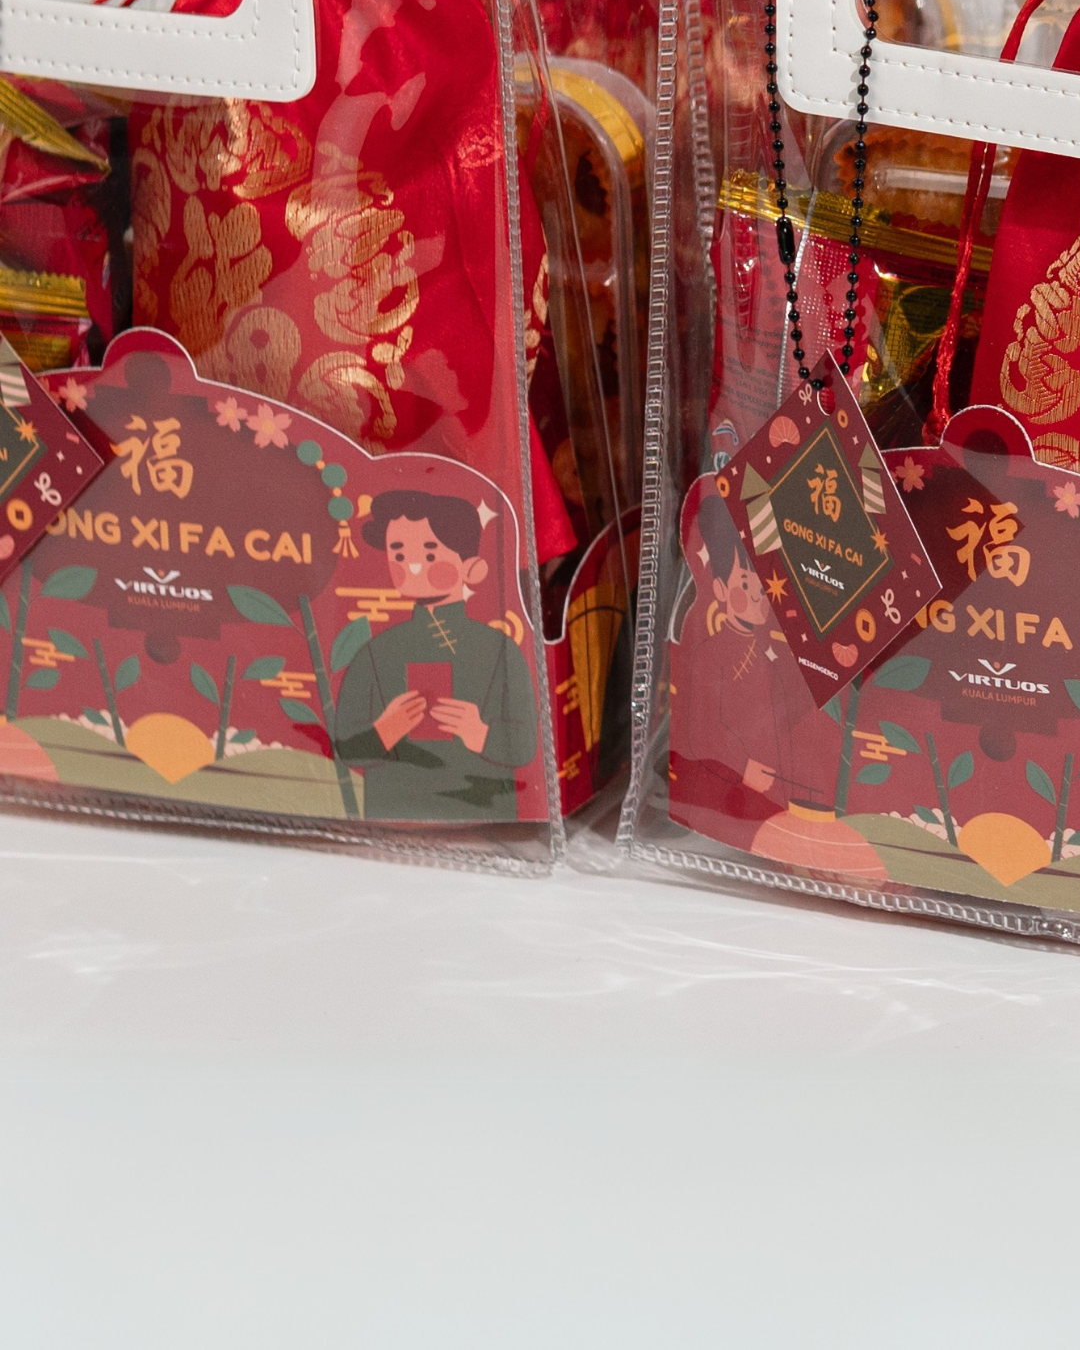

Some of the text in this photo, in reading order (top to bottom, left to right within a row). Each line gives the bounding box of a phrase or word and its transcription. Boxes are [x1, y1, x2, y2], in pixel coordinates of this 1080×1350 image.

[110, 415, 194, 499] 福
[807, 463, 842, 523] 福
[130, 515, 170, 551] XI
[179, 522, 235, 559] FA
[244, 529, 312, 564] CAI
[783, 518, 863, 567] GONG XI FA CAI
[946, 498, 1031, 587] 福
[114, 577, 213, 601] VIRTUOS
[800, 562, 845, 590] VIRTUOS
[966, 605, 1005, 641] XI
[1015, 612, 1073, 651] FA
[948, 669, 1051, 694] VIRTUOS
[962, 688, 1037, 707] KUALA LUMPUR
